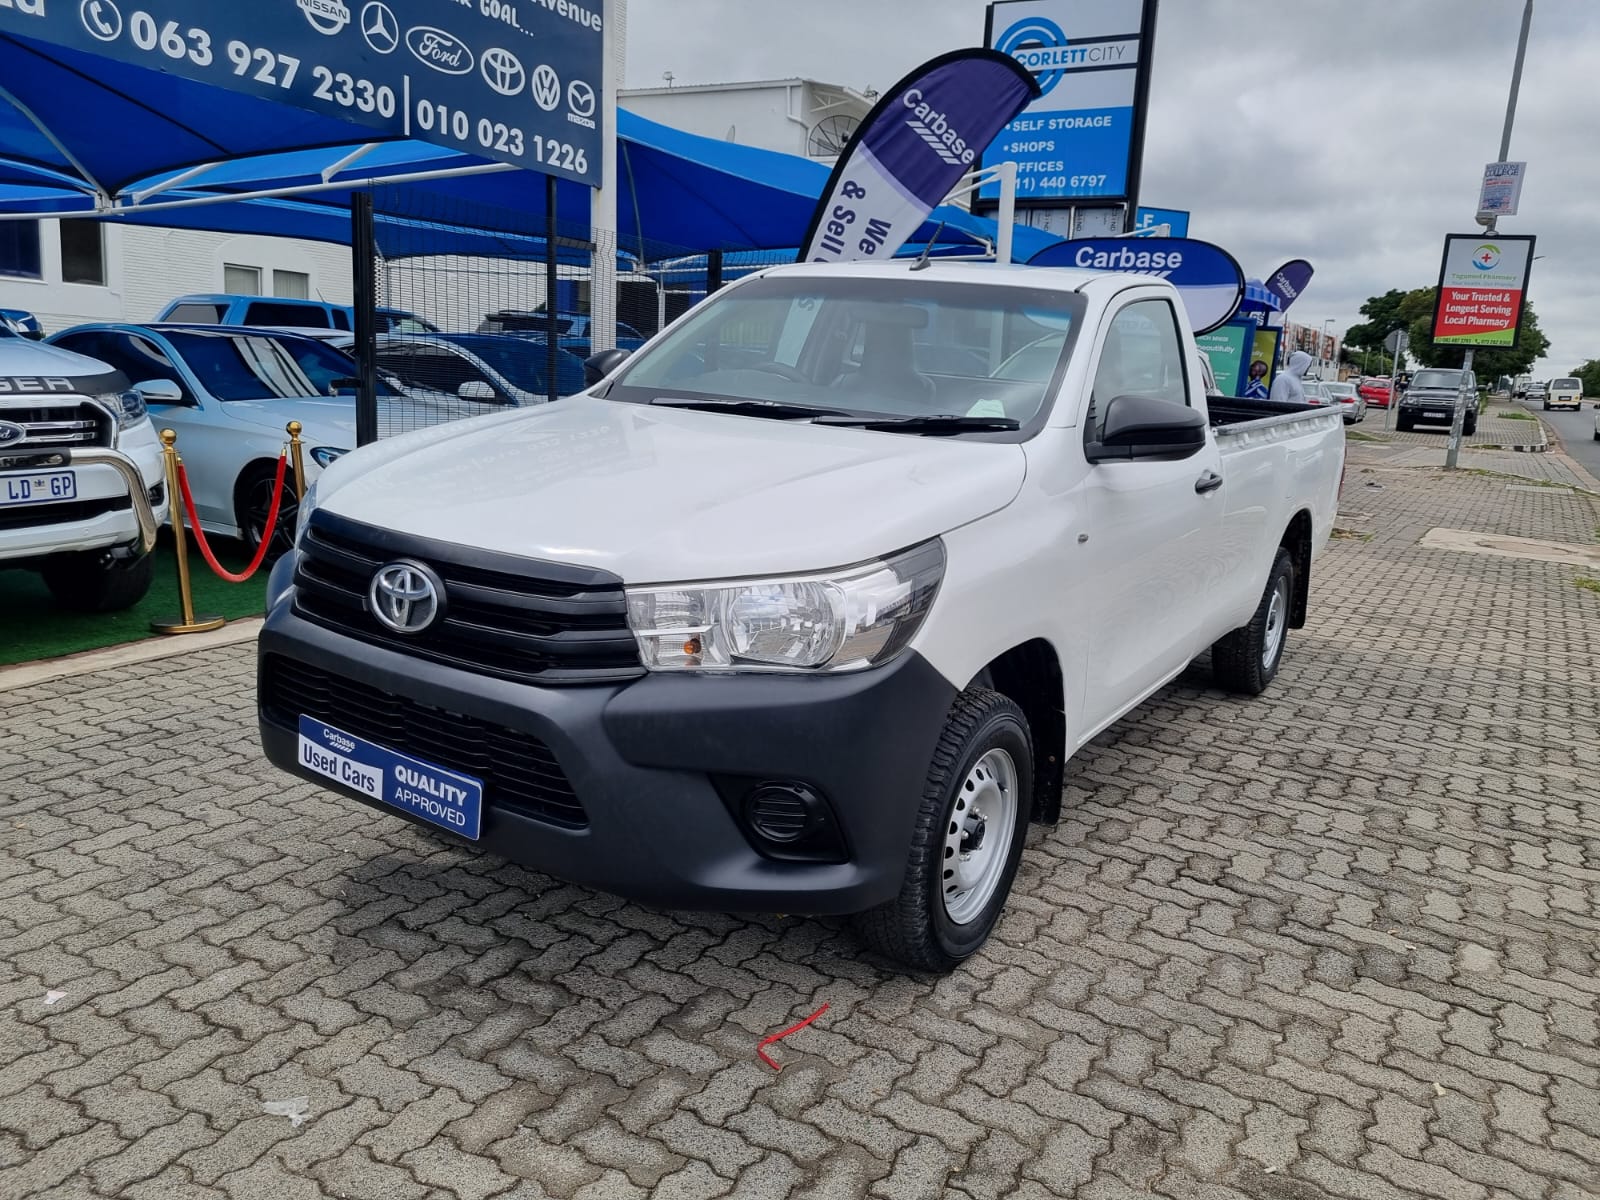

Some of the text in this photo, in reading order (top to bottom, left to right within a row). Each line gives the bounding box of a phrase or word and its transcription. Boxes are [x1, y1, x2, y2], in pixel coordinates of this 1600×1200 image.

[419, 32, 463, 67] Ford
[130, 10, 588, 175] 063 927 2330 010 023 1226
[567, 113, 596, 130] mazda
[902, 88, 975, 164] Carbase
[1012, 116, 1112, 131] SELF STORAGE
[1011, 141, 1055, 153] SHOPS
[1018, 160, 1064, 173] FFICES
[840, 180, 866, 199] &
[1015, 175, 1107, 192] 11) 440 6797
[820, 205, 856, 255] Sell
[858, 217, 892, 256] We
[1075, 245, 1183, 268] Carbase
[1276, 272, 1297, 298] Carbase
[1452, 291, 1511, 302] Your Trusted &
[1446, 303, 1512, 317] Longest Serving
[1444, 315, 1510, 329] Local Pharmacy
[8, 476, 72, 500] LD GP
[323, 728, 356, 749] Carbase
[303, 743, 375, 793] Used Cars
[394, 764, 467, 807] QUALITY
[395, 787, 466, 827] APPROVED
